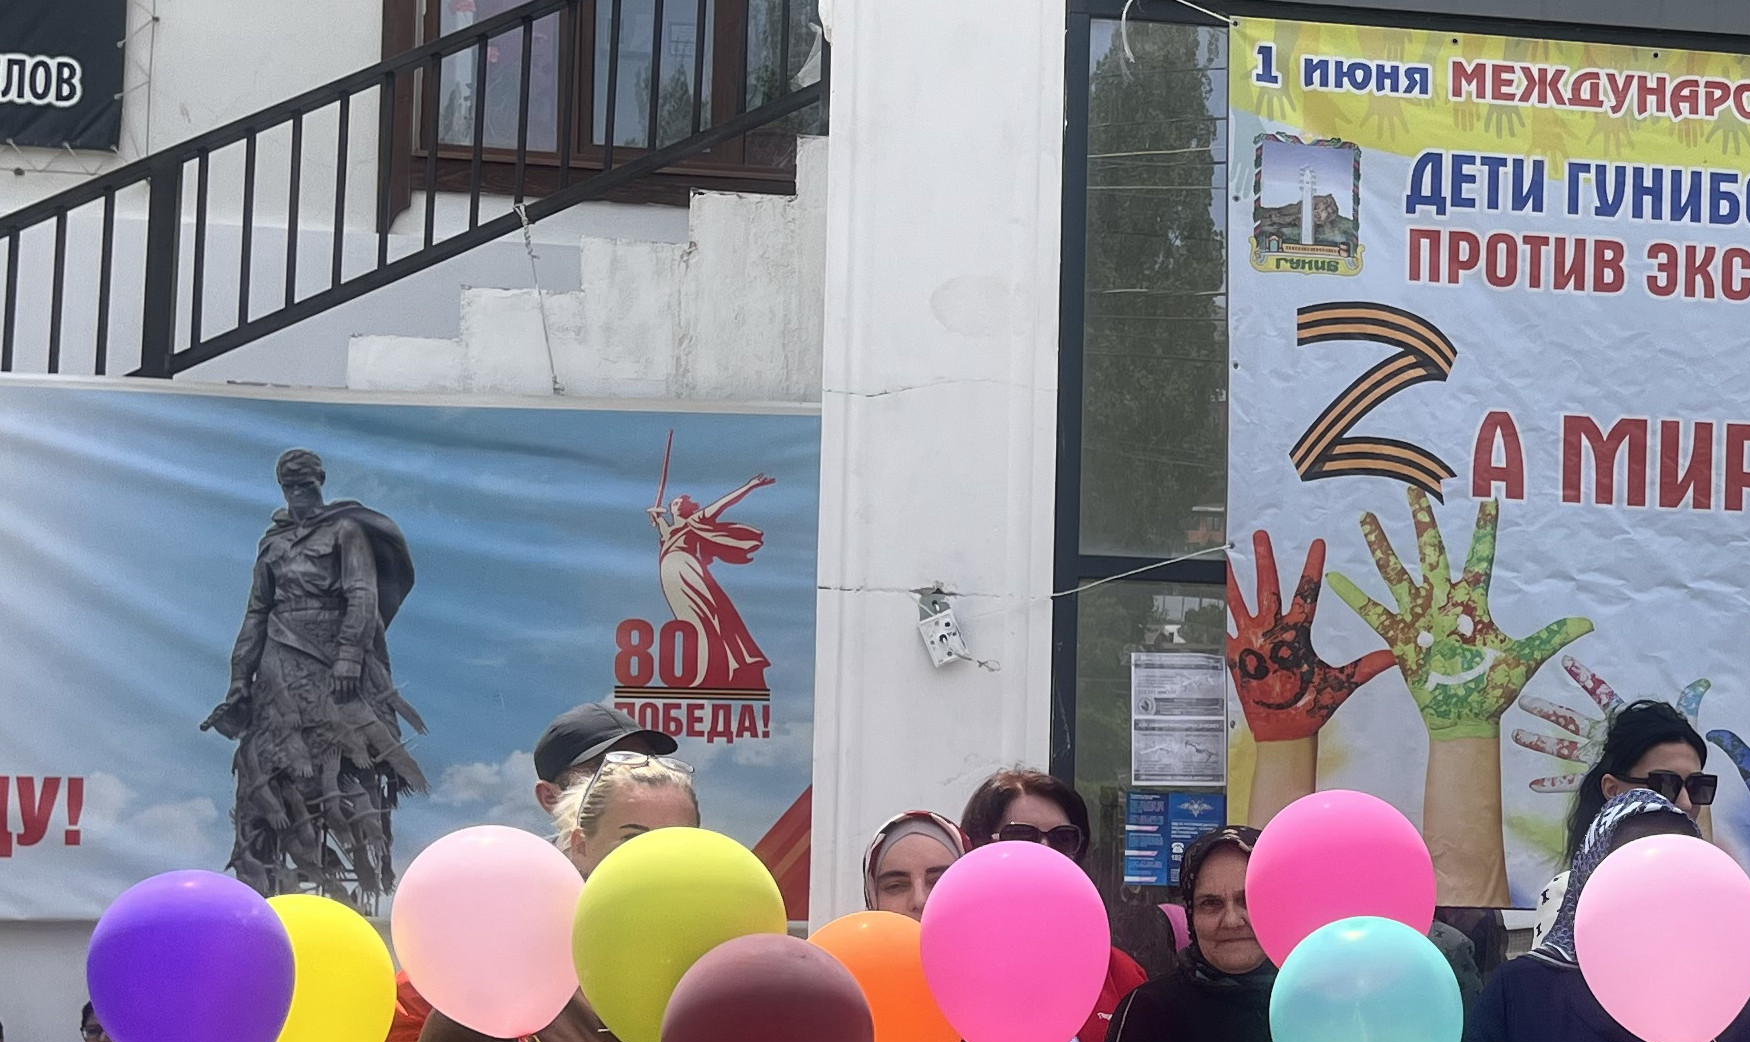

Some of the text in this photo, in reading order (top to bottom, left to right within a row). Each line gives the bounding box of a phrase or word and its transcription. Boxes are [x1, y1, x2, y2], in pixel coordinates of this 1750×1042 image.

[1255, 45, 1279, 84] 1
[1406, 152, 1545, 215] ДЕТИ
[1409, 228, 1625, 293] ПРОТИВ
[614, 618, 699, 687] 80
